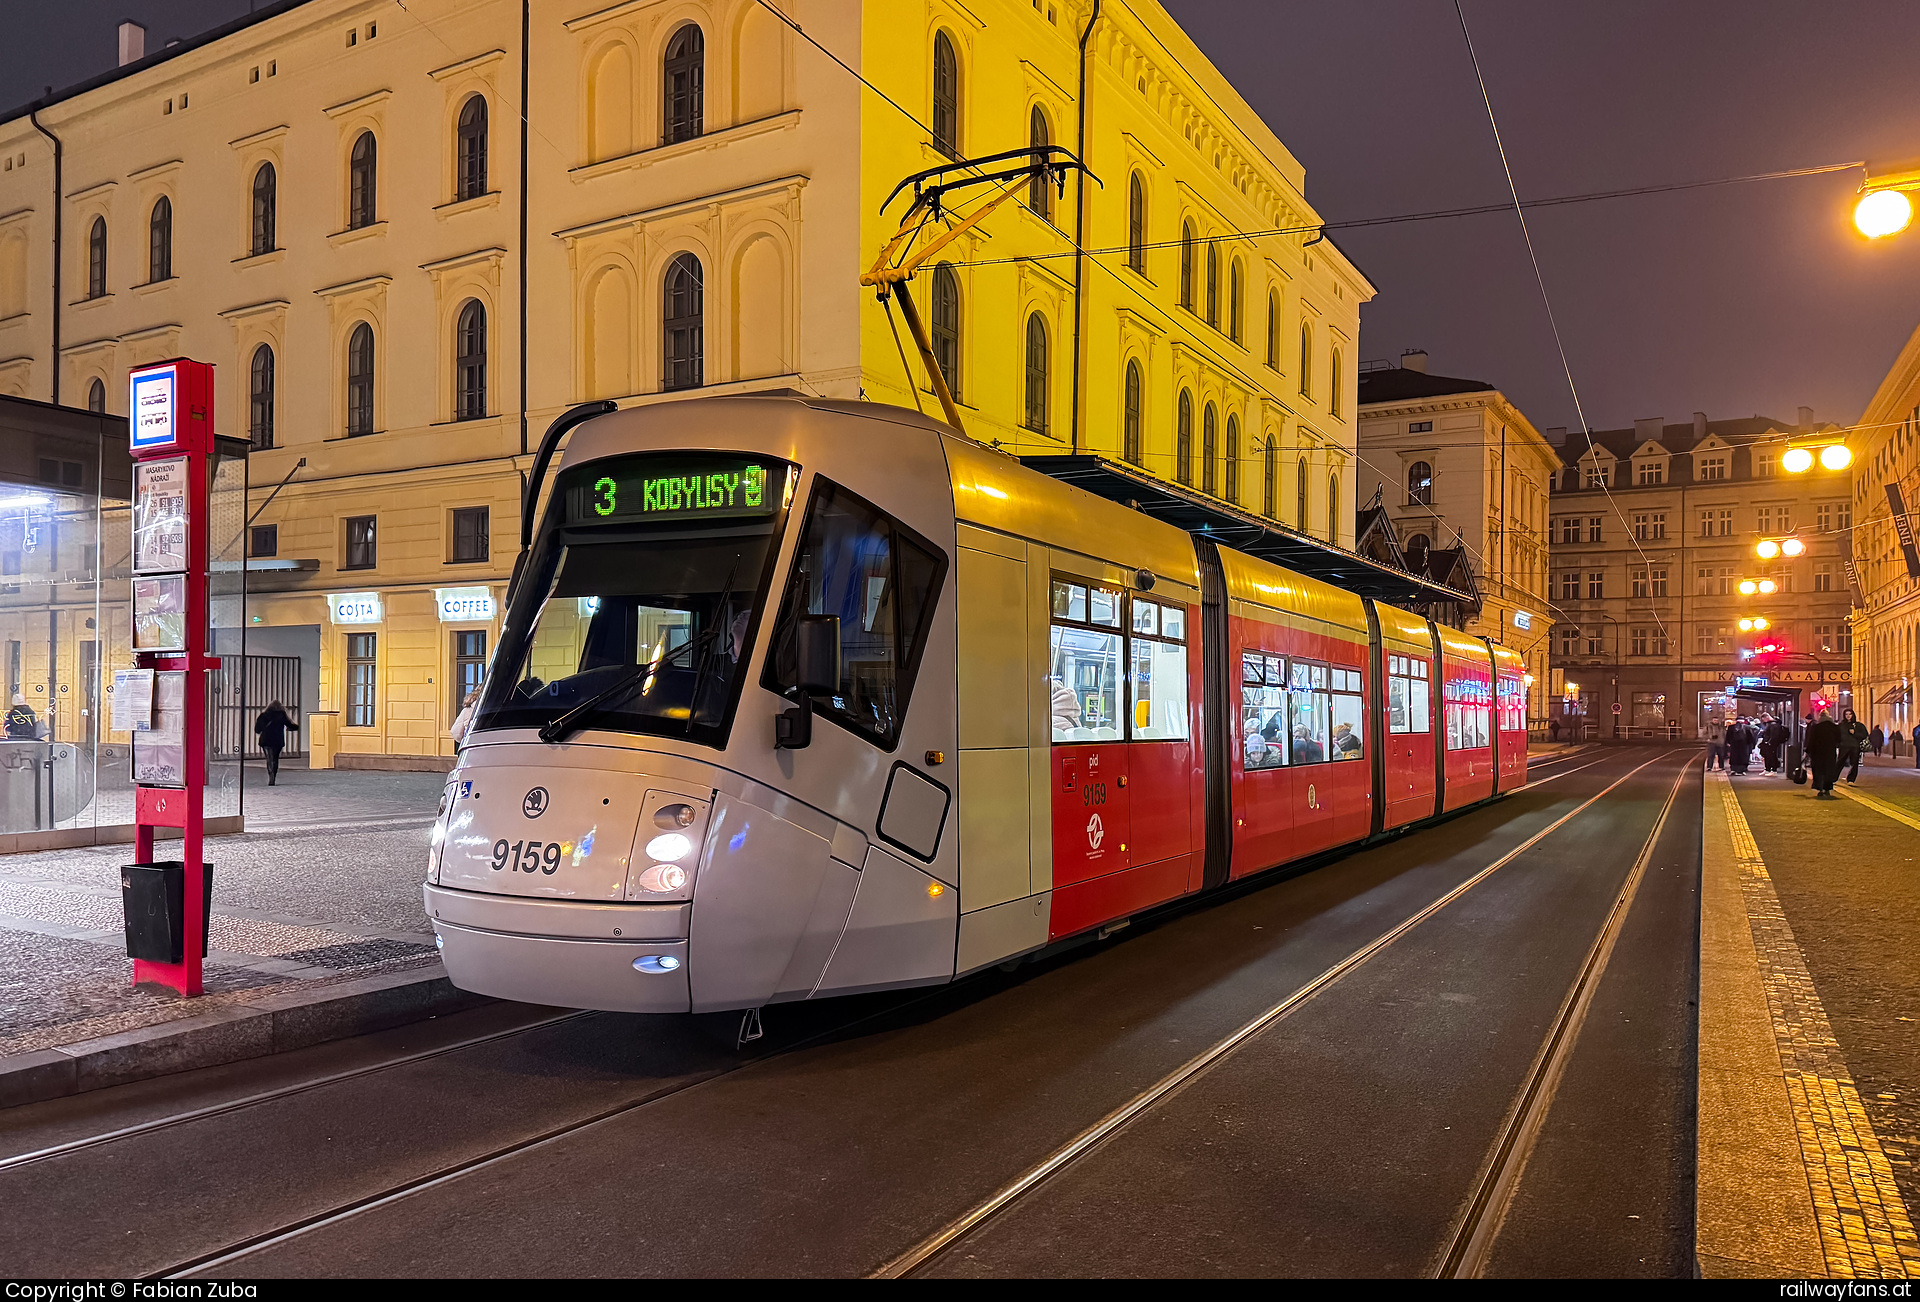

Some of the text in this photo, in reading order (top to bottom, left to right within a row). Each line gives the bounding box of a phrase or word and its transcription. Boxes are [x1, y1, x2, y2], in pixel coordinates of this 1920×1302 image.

[145, 464, 175, 474] MASARYKOVO
[150, 473, 170, 483] NÁDRAŽÍ
[594, 472, 739, 516] 3 KOBYLISY
[161, 498, 169, 507] 91
[171, 497, 183, 506] 905
[161, 534, 169, 544] 92
[338, 600, 489, 617] COSTA COFFEE
[1718, 671, 1793, 681] KAVNA
[1089, 753, 1099, 769] pid
[1083, 783, 1107, 807] 9159
[491, 838, 562, 876] 9159
